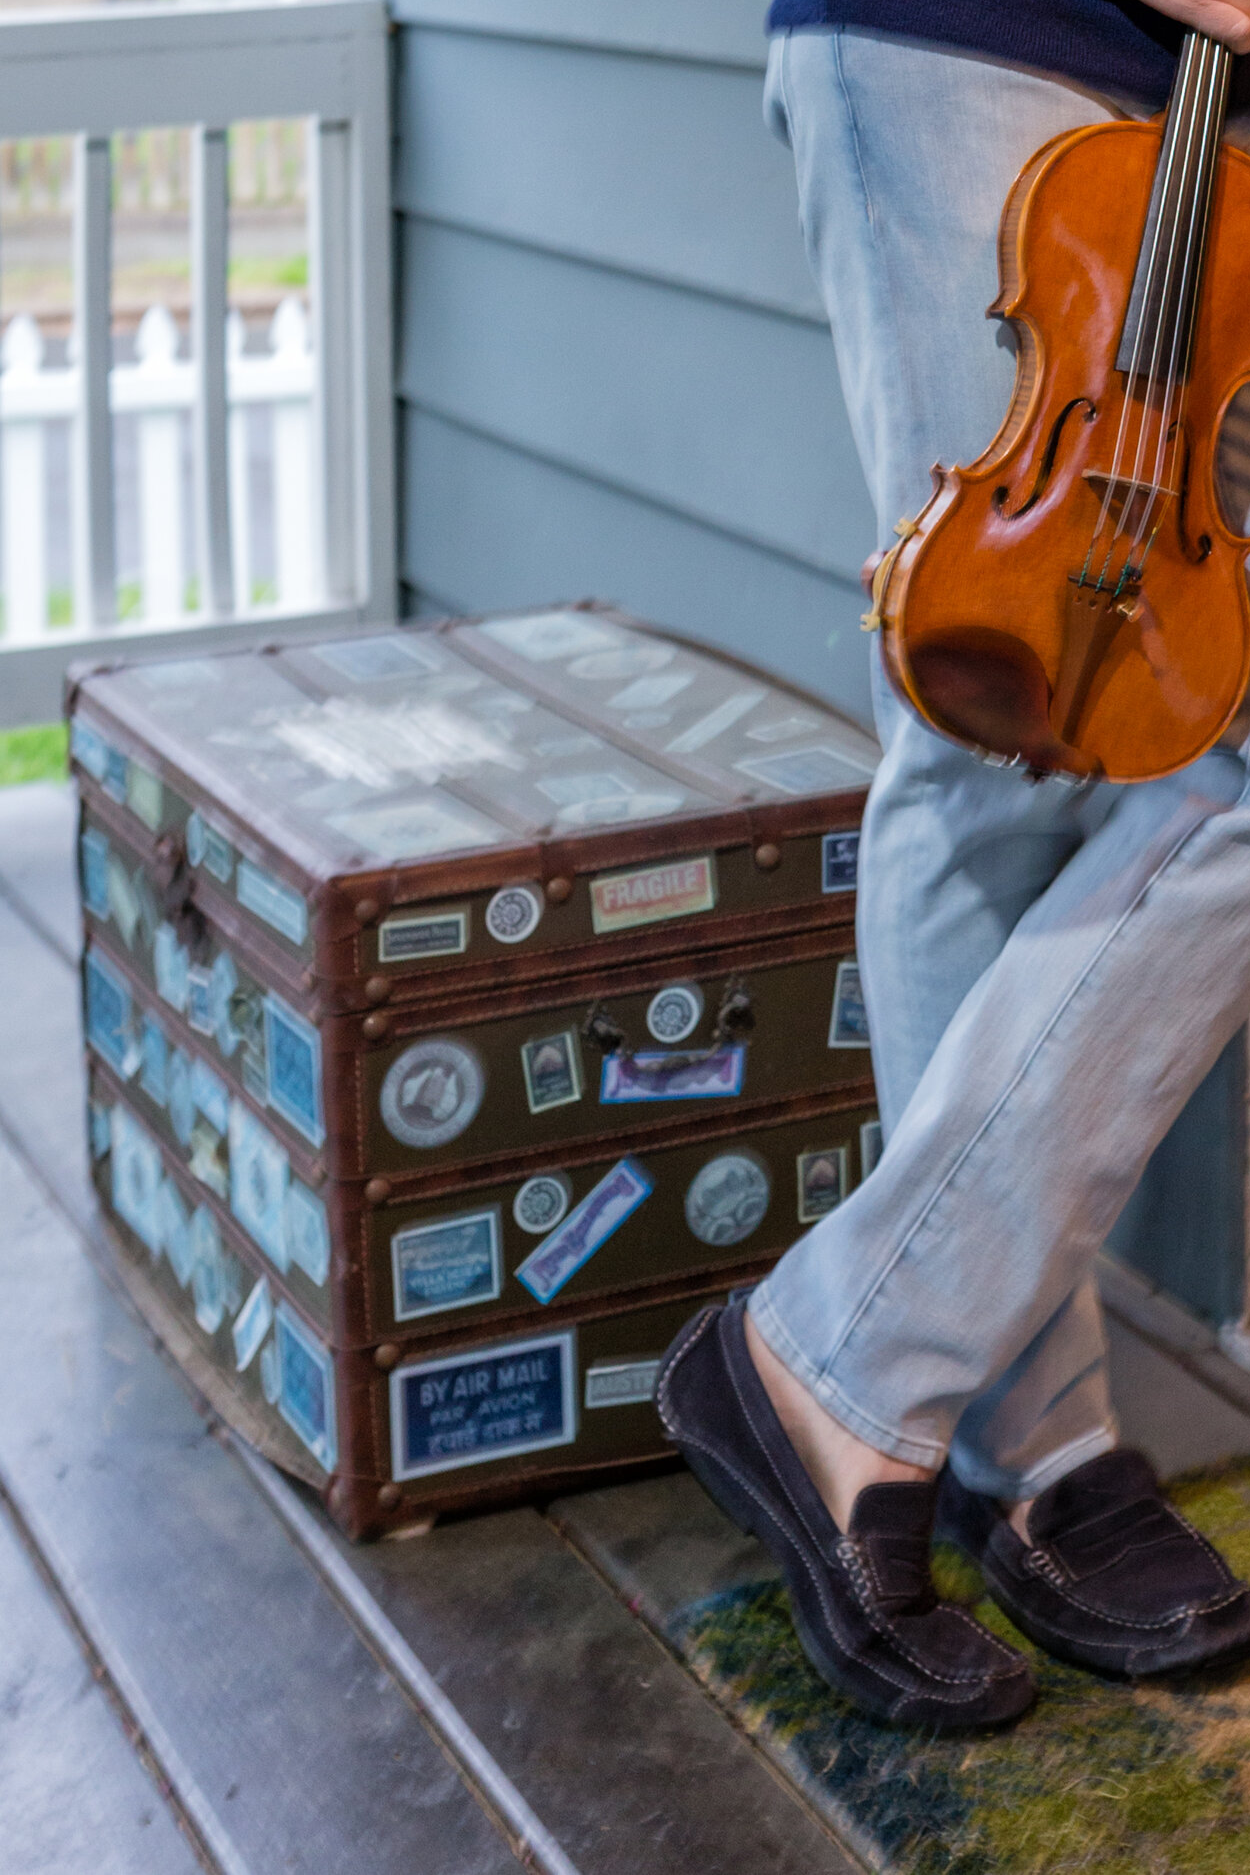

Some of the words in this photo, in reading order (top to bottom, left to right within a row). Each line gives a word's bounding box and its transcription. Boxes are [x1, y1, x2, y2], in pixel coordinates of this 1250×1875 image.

[603, 866, 698, 909] FRAGILE
[420, 1377, 449, 1408] BY
[452, 1370, 490, 1399] AIR
[496, 1358, 550, 1391] MAIL
[430, 1405, 466, 1427] PAR
[478, 1390, 538, 1416] AVION
